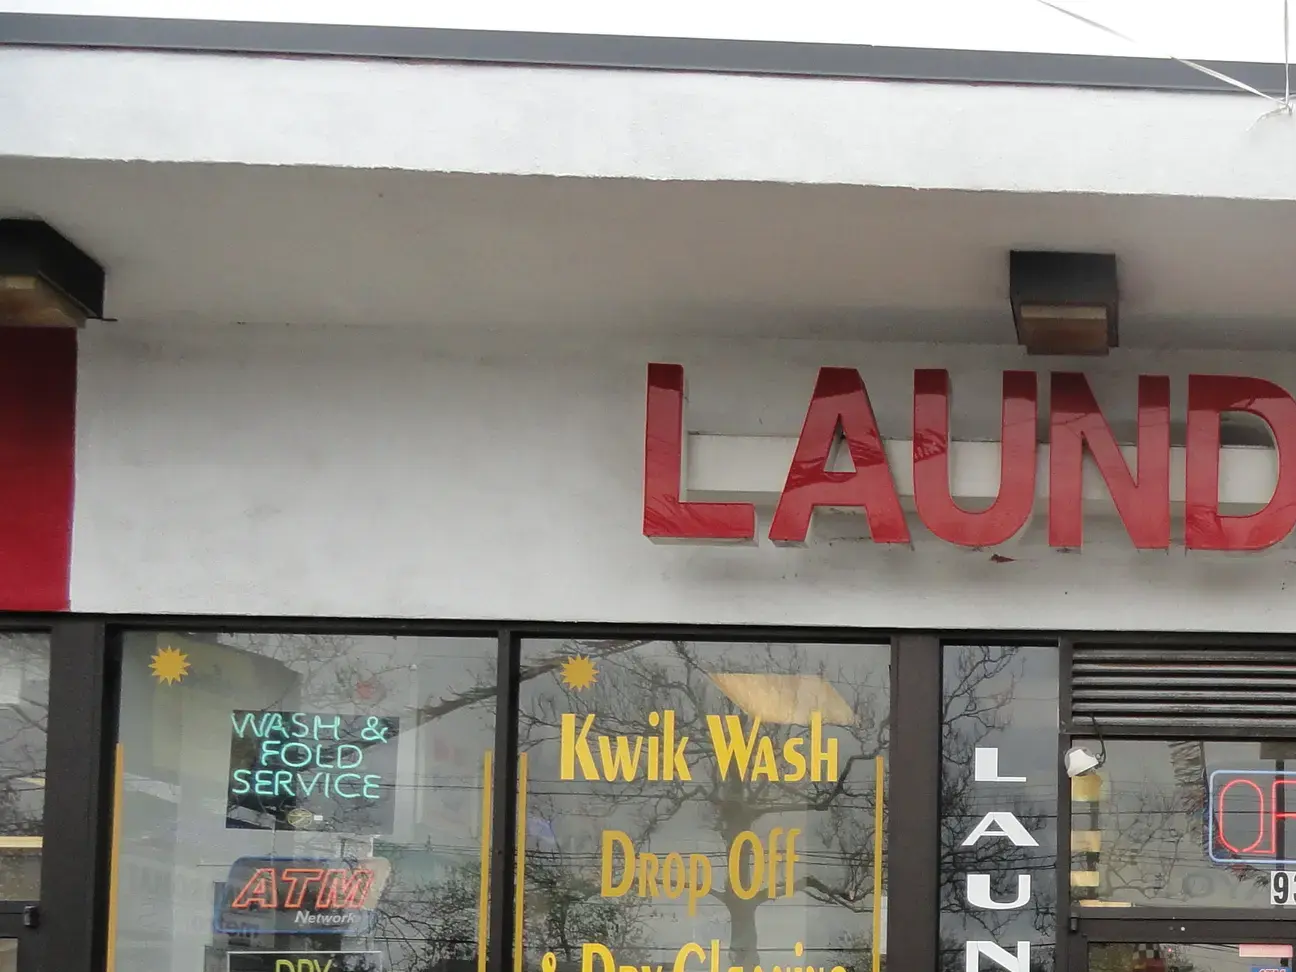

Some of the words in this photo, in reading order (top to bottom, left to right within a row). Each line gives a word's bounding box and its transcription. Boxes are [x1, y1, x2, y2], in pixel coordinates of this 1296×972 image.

[231, 712, 340, 740] WASH
[360, 715, 388, 743] &
[260, 740, 364, 769] FOLD
[232, 769, 381, 799] SERVICE
[232, 867, 376, 909] ATM
[294, 909, 357, 925] Network
